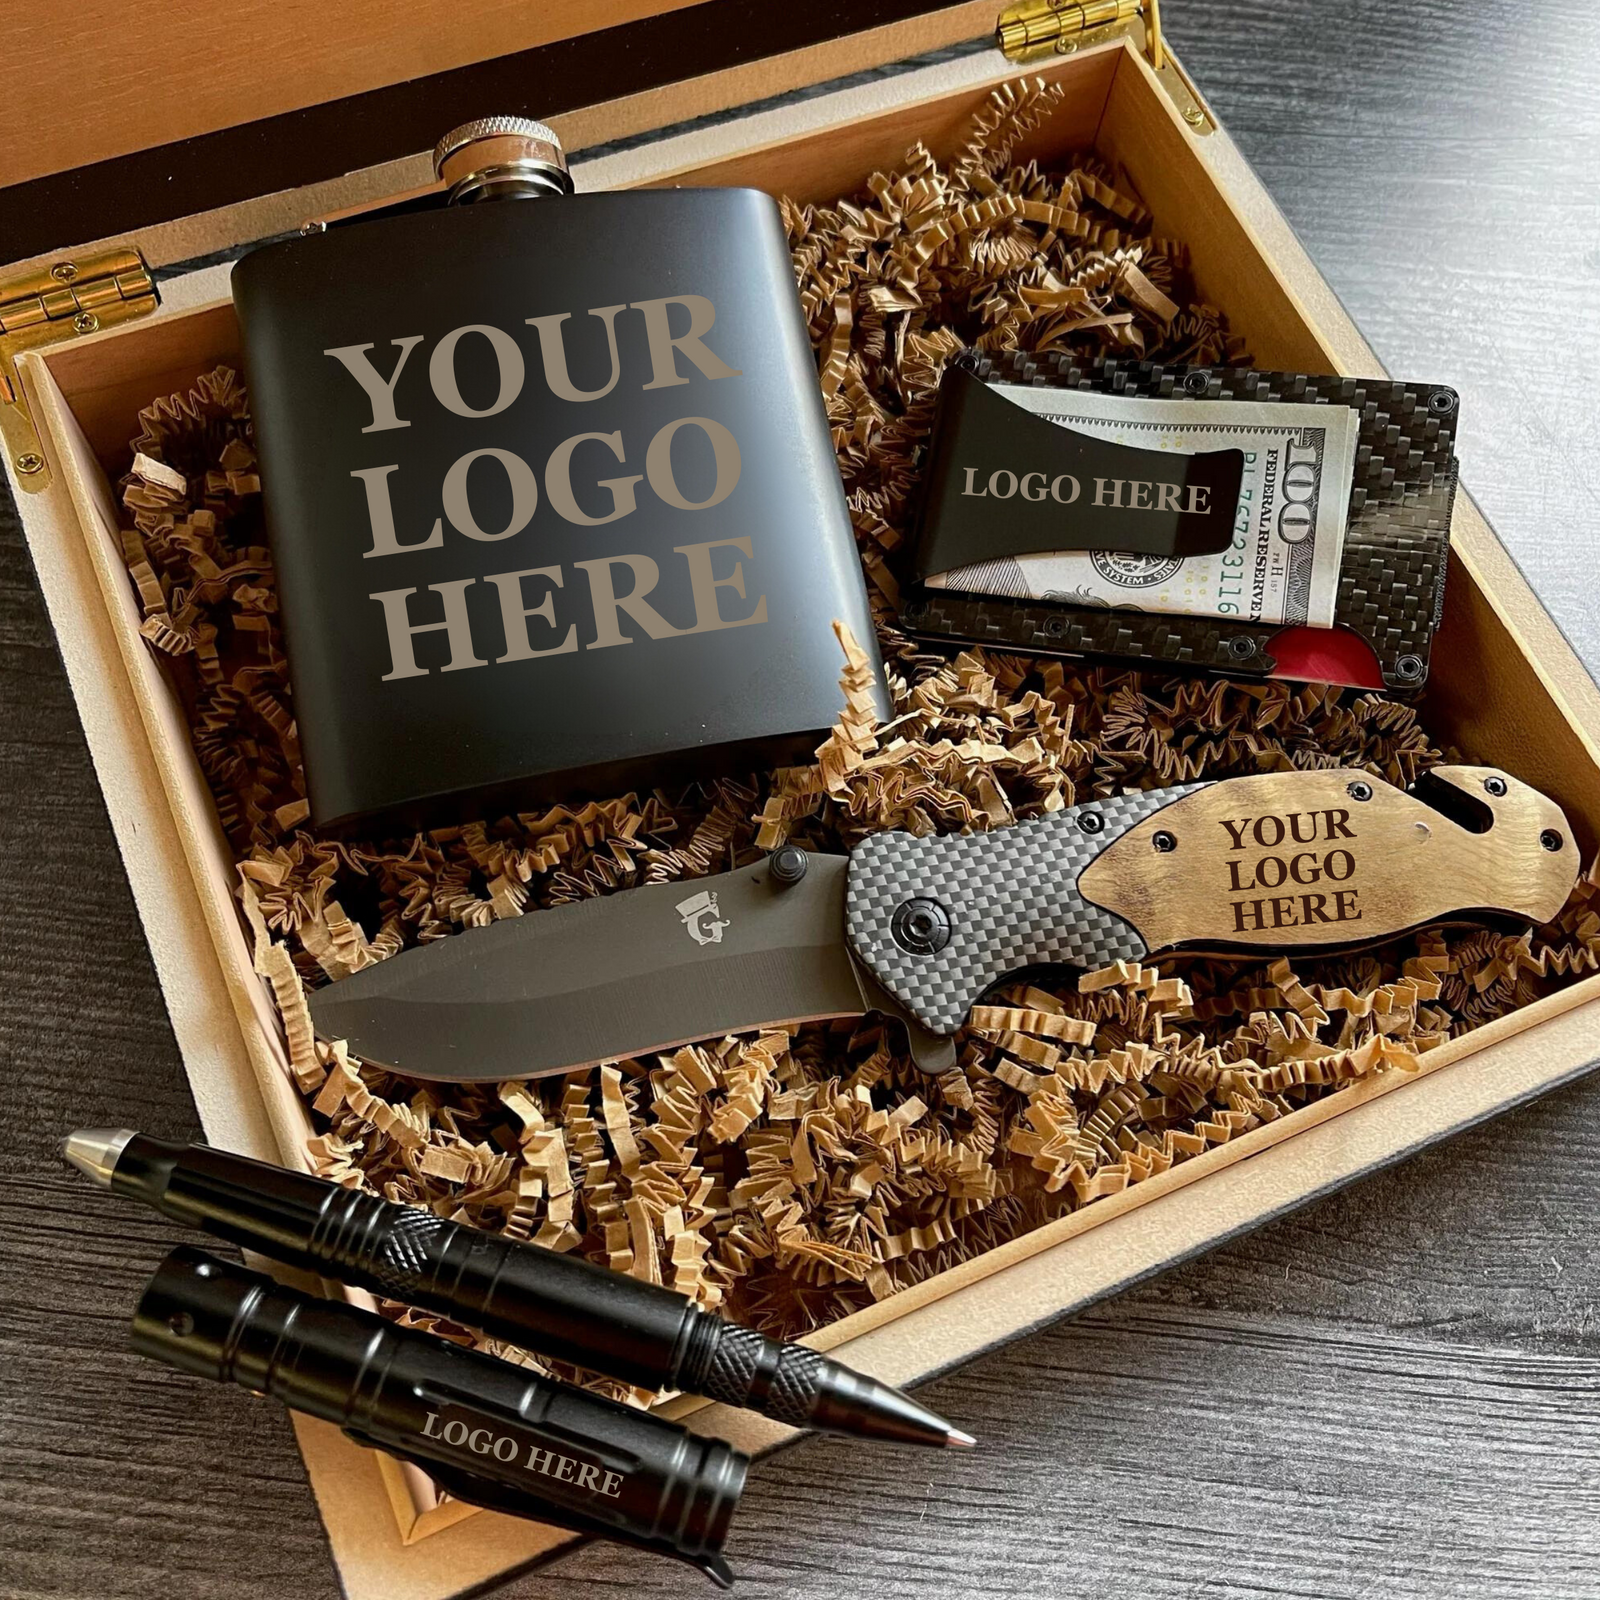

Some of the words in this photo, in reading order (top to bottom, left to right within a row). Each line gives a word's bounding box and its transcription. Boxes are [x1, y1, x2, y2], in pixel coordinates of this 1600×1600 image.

[324, 294, 743, 433] YOUR
[350, 416, 742, 559] LOGO
[961, 467, 1081, 504] LOGO
[1090, 477, 1212, 515] HERE
[1259, 448, 1279, 528] FEDERAL
[1277, 437, 1317, 544] 100
[369, 535, 769, 682] HERE
[1103, 564, 1144, 584] SYSTEM
[1251, 528, 1271, 616] RESERVE
[1271, 566, 1284, 576] H
[1218, 808, 1358, 850] YOUR
[1225, 849, 1356, 892] LOGO
[1229, 889, 1362, 933] HERE
[419, 1411, 519, 1462] LOGO
[523, 1445, 625, 1498] HERE
